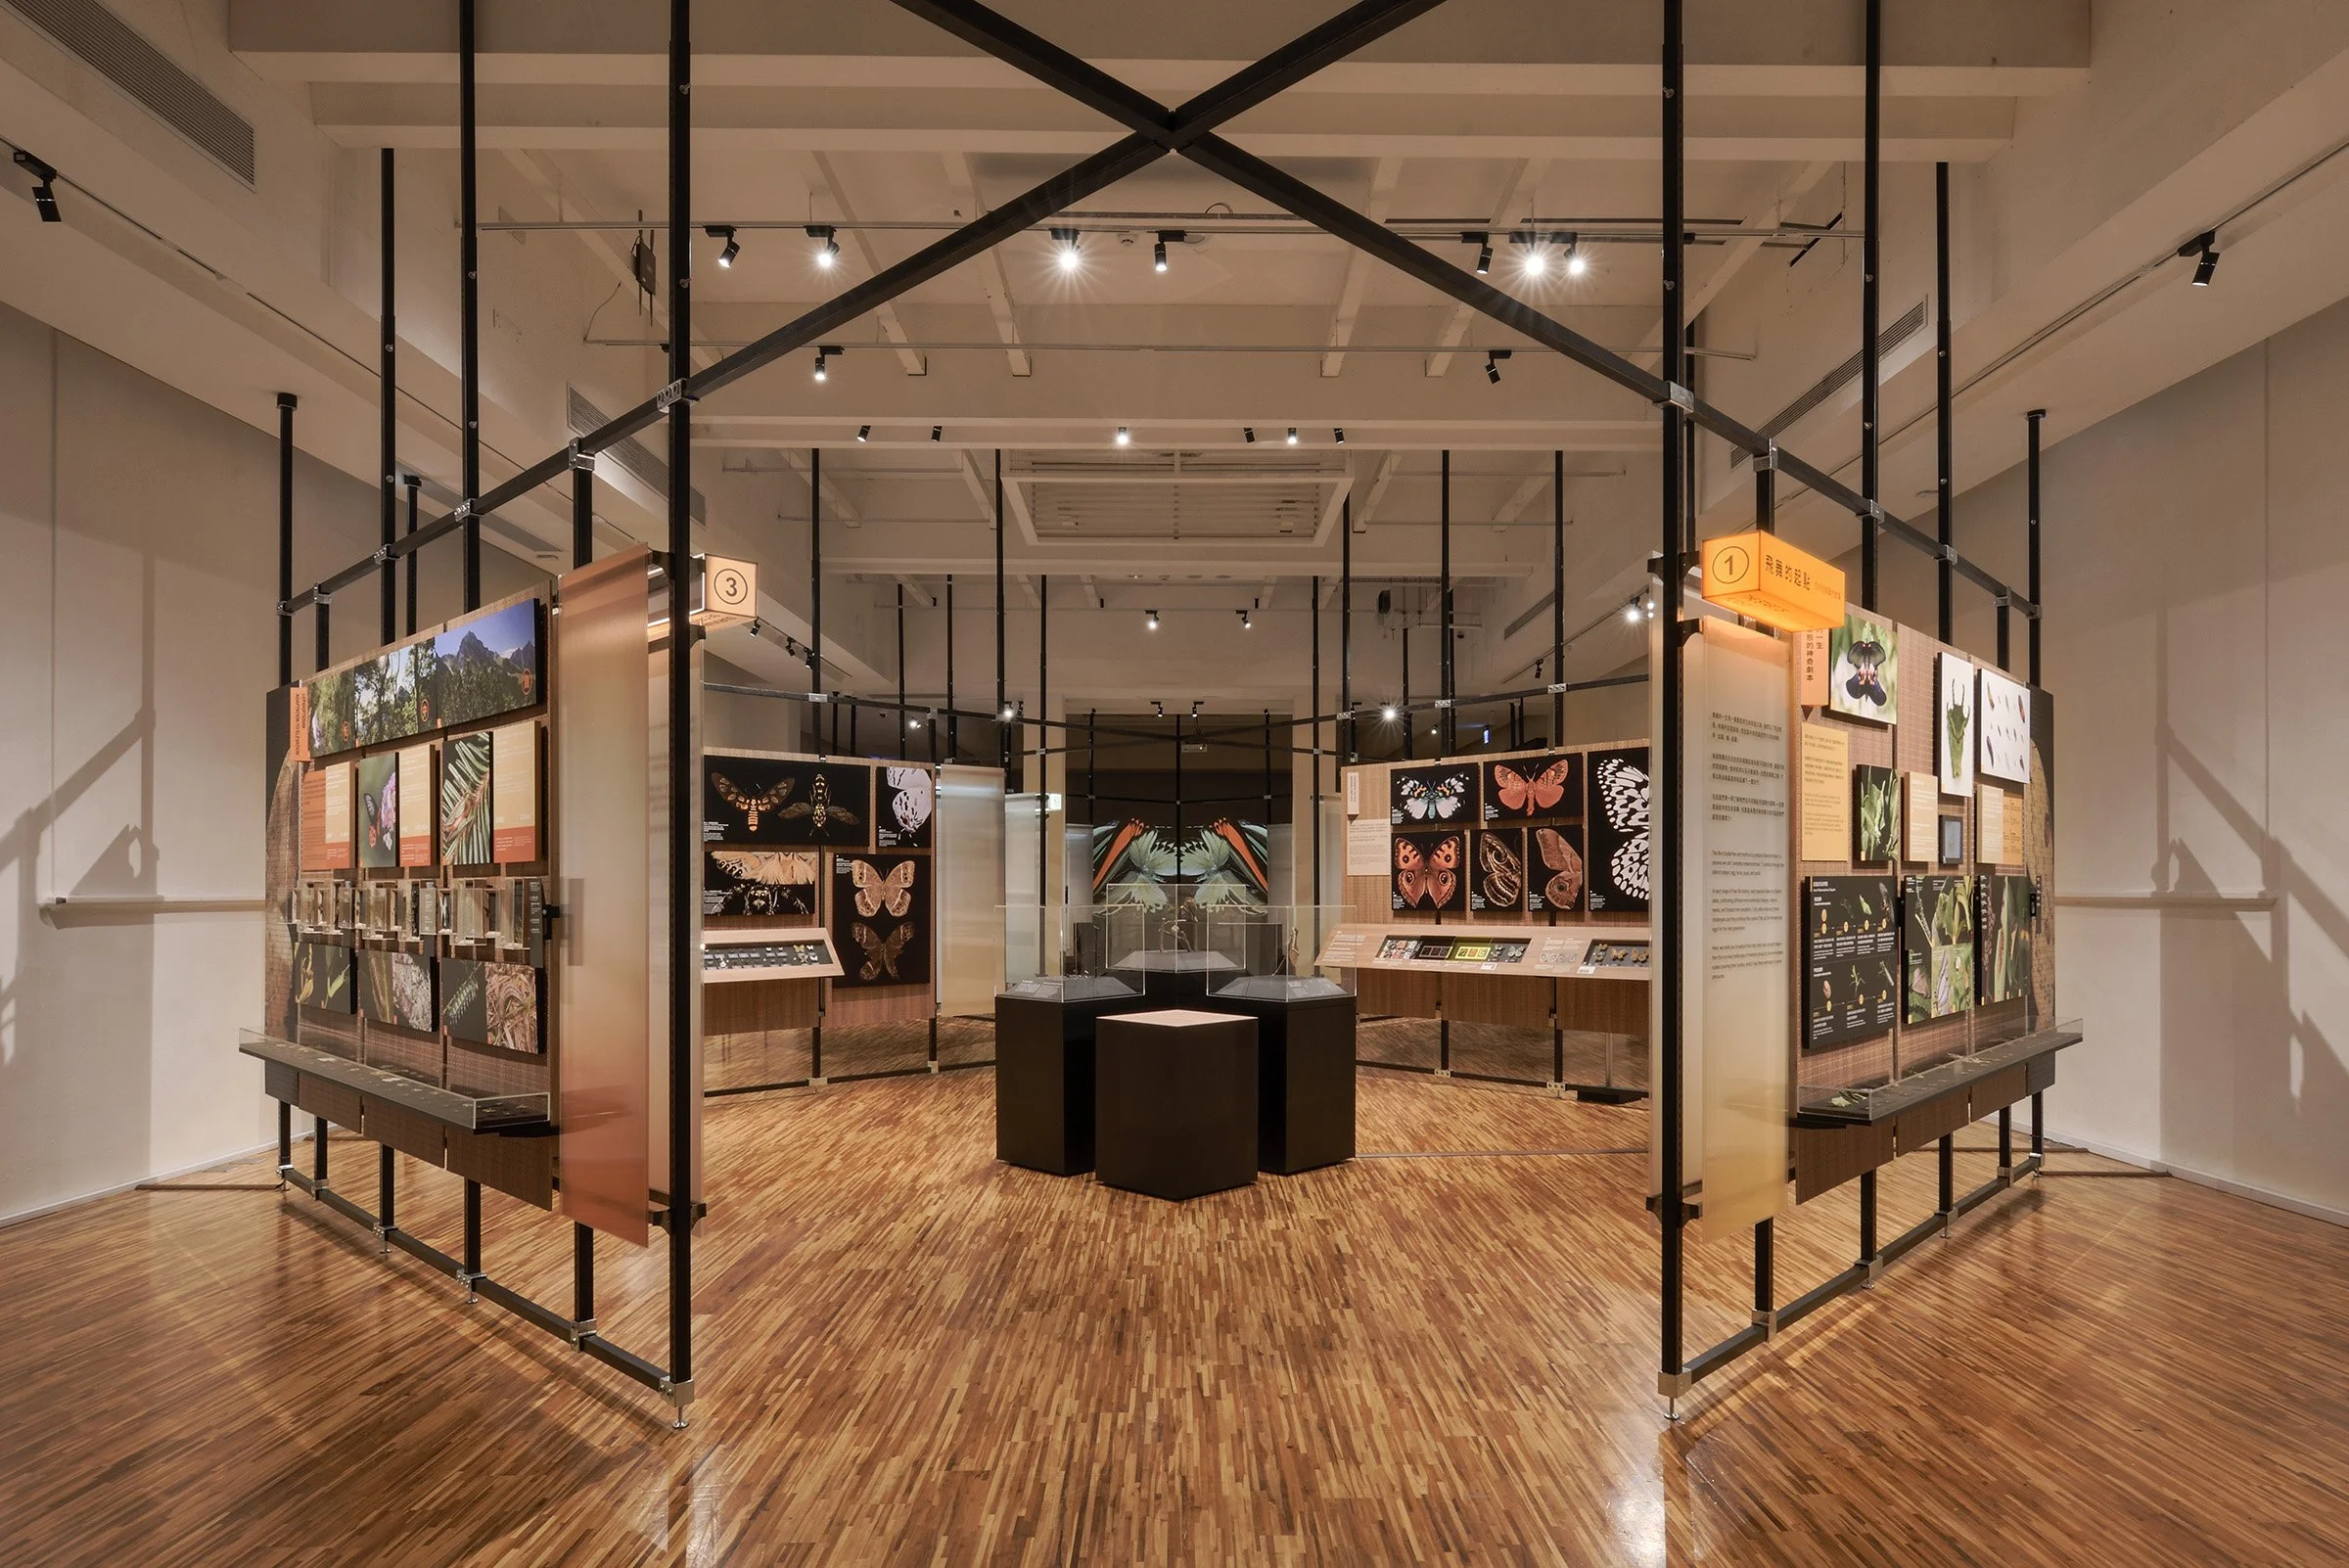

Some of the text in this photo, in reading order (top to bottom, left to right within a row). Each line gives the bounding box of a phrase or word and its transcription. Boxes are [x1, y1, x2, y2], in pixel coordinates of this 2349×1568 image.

[1724, 554, 1734, 576] 1
[1765, 555, 1811, 591] 飛舞的起點
[724, 576, 738, 597] 3
